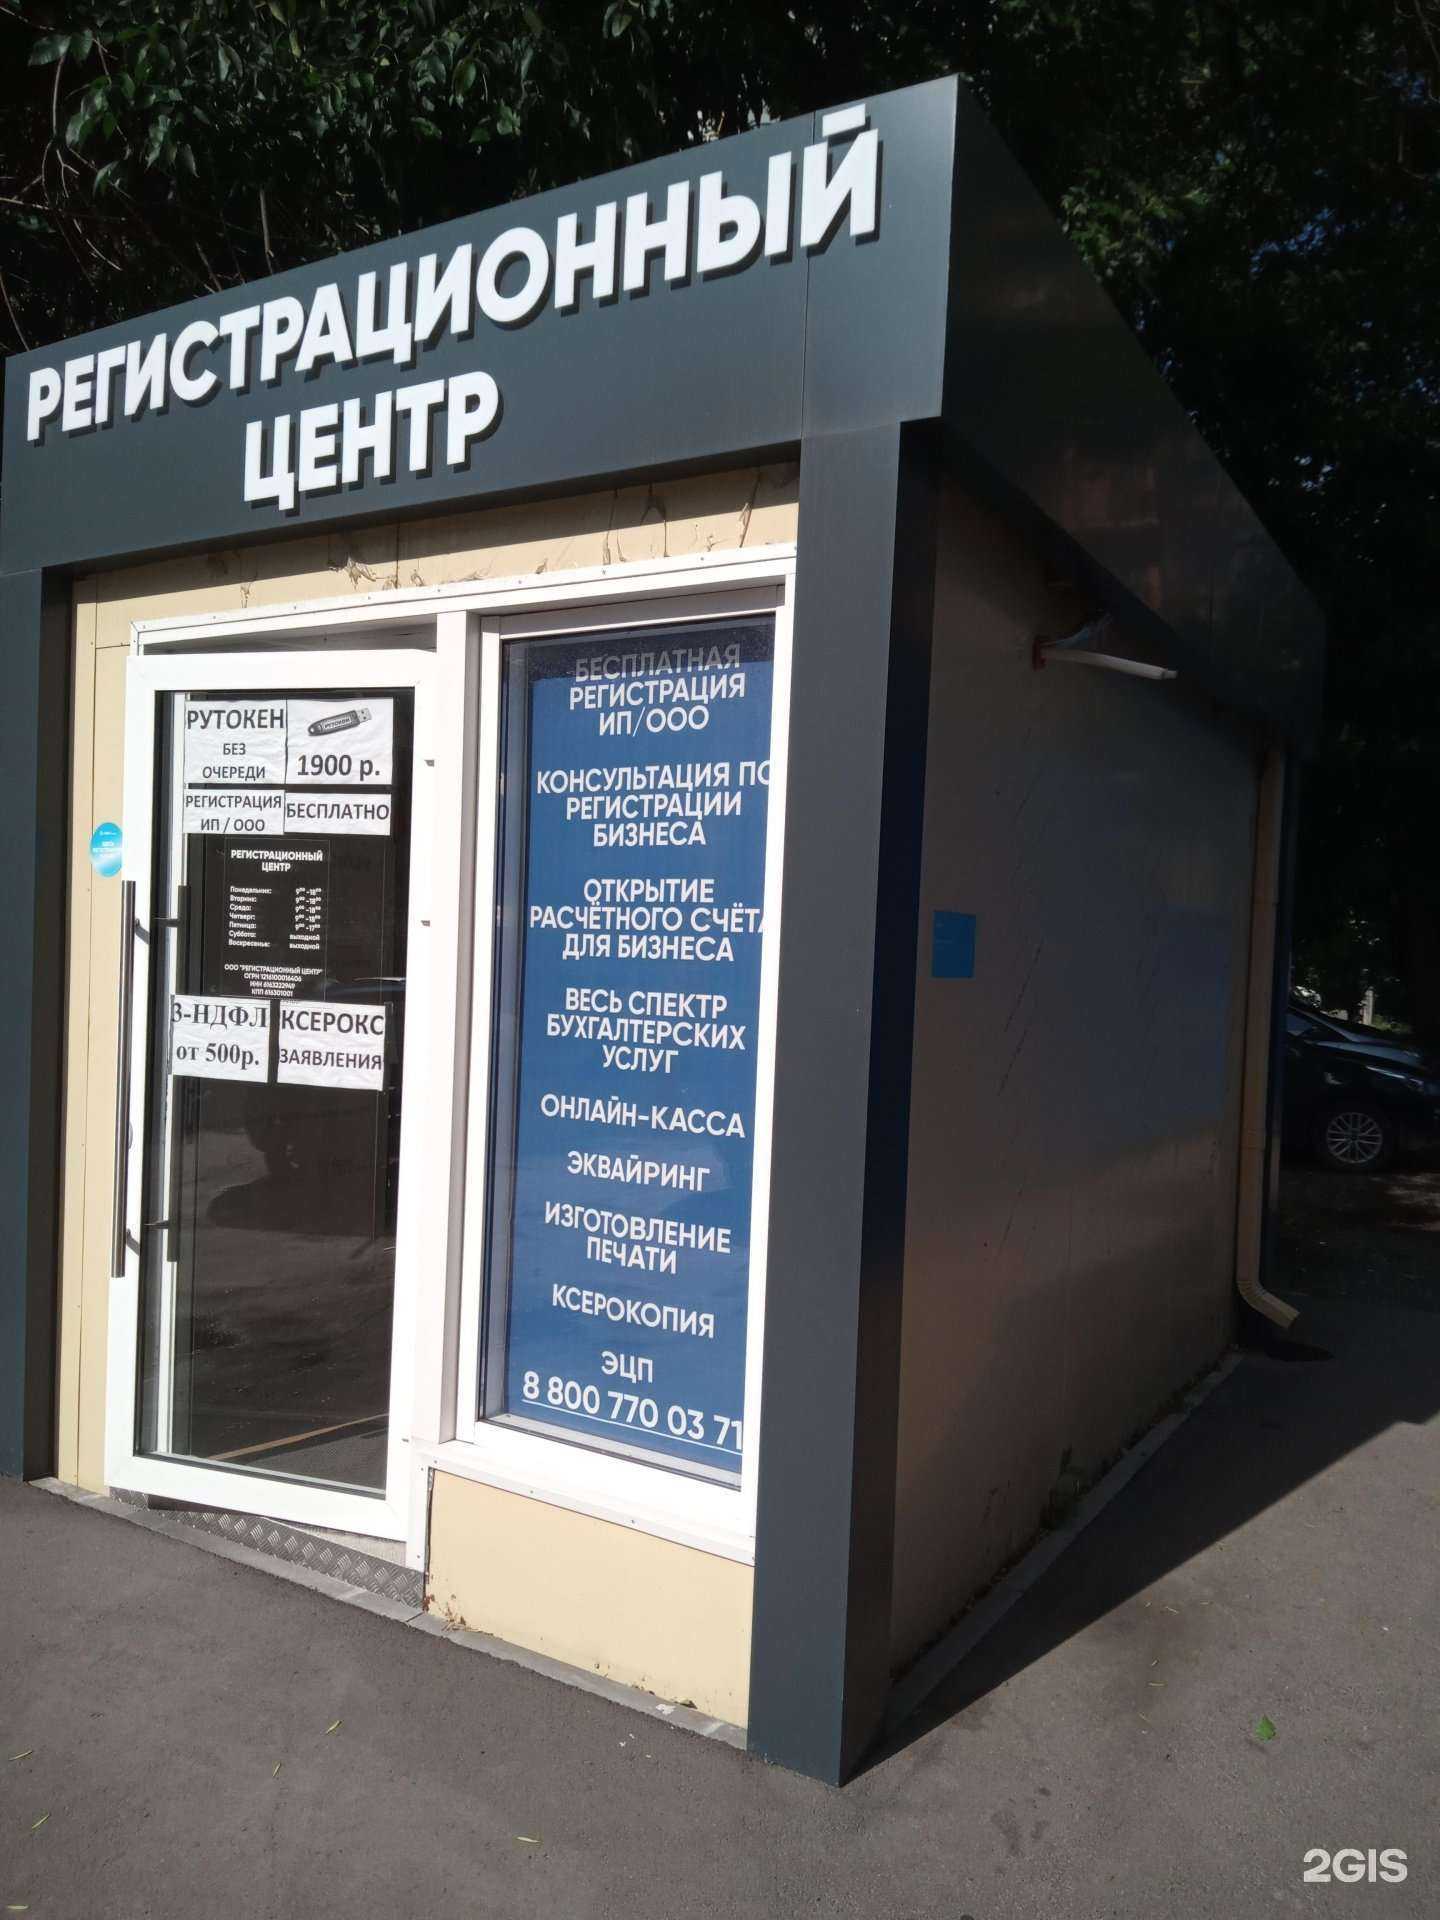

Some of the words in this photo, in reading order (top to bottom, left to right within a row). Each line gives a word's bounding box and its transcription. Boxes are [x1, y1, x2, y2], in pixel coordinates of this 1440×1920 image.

[27, 104, 879, 442] РЕГИСТРАЦИОННЫЙ
[243, 371, 499, 512] ЦЕНТР
[575, 643, 741, 683] БЕСПЛАТНАЯ
[569, 672, 746, 711] РЕГИСТРАЦИЯ
[186, 709, 285, 730] РУТОКЕН
[598, 705, 710, 737] ИП/ООО
[222, 742, 246, 756] БЕЗ
[202, 765, 266, 782] ОЧЕРЕДИ
[297, 754, 351, 776] 1900
[537, 762, 730, 794] КОНСУЛЬТАЦИЯ
[185, 795, 282, 810] РЕГИСТРАЦИЯ
[287, 803, 390, 820] БЕСПЛАТНО
[566, 791, 742, 821] РЕГИСТРАЦИИ
[201, 818, 220, 832] ИП
[234, 818, 265, 832] ООО
[593, 820, 706, 847] БИЗНЕСА
[231, 849, 323, 861] РЕГИСТРАЦИОННЫЙ
[261, 862, 291, 872] ЦЕНТР
[583, 878, 715, 903] ОТКРЫТИЕ
[530, 901, 683, 932] РАСЧЁТНОГО
[562, 933, 610, 960] ДЛЯ
[617, 935, 735, 962] БИЗНЕСА
[171, 1002, 268, 1032] 3-НДФЛ
[565, 987, 623, 1014] ВЕСЬ
[628, 991, 728, 1019] СПЕКТР
[281, 1009, 384, 1036] КСЕРОКС
[546, 1013, 746, 1051] БУХГАЛТЕРСКИХ
[176, 1046, 199, 1061] от
[205, 1043, 259, 1070] 500р.
[279, 1048, 383, 1070] ЗАЯВЛЕНИЯ
[602, 1045, 679, 1074] УСЛУГ
[540, 1093, 745, 1138] ОНЛАЙН-КАССА
[567, 1150, 710, 1192] ЭКВАЙРИНГ
[544, 1201, 732, 1254] ИЗГОТОВЛЕНИЕ
[587, 1235, 677, 1275] ПЕЧАТИ
[552, 1283, 715, 1339] КСЕРОКОПИЯ
[601, 1350, 653, 1384] ЭЦП
[522, 1370, 540, 1400] 8
[547, 1376, 600, 1415] 800
[607, 1391, 659, 1429] 770
[667, 1405, 704, 1440] 03
[713, 1414, 743, 1450] 71
